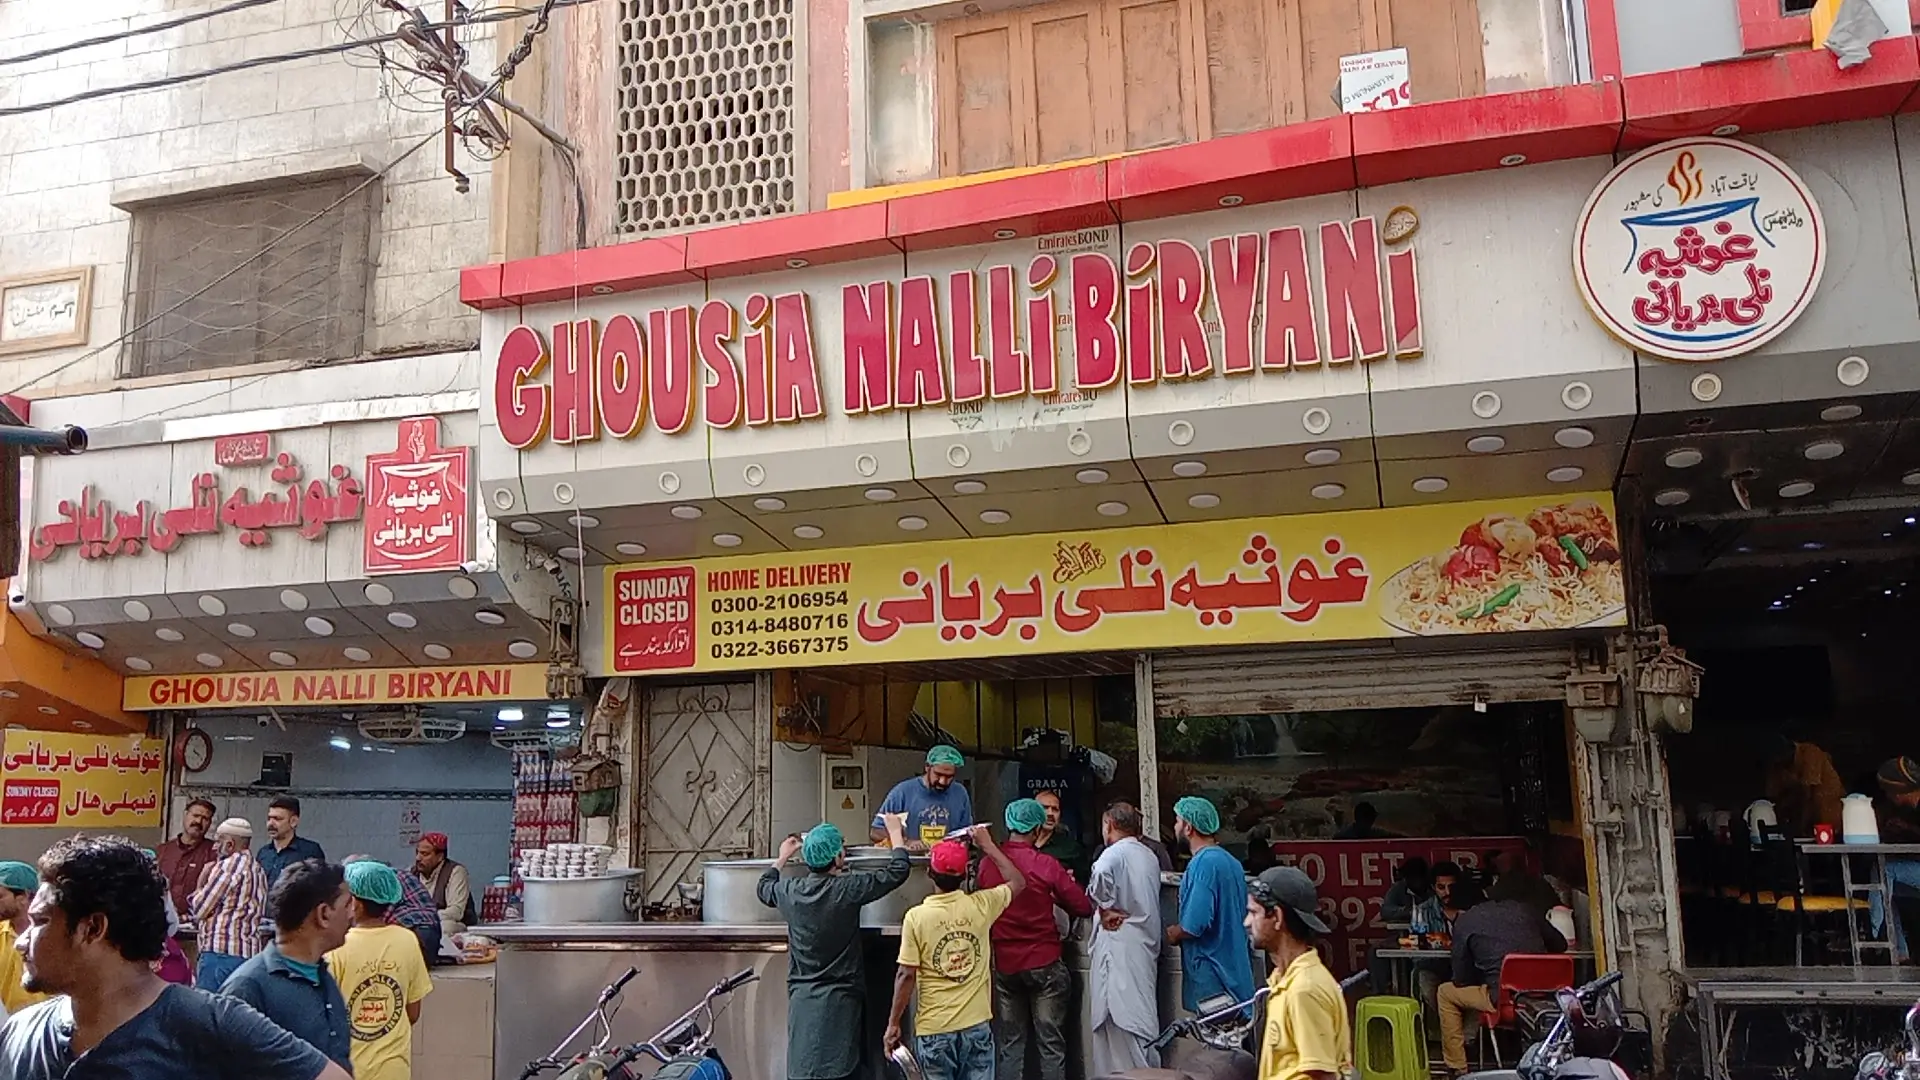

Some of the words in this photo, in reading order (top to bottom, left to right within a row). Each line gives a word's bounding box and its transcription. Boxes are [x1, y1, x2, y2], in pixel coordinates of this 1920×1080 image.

[619, 575, 690, 602] SUNDAY
[707, 568, 760, 593] HOME
[765, 562, 852, 588] DELIVERY
[1054, 549, 1165, 633] نلی
[1171, 535, 1369, 622] غوثیہ
[619, 601, 689, 627] CLOSED
[711, 590, 849, 614] 0300-2106954
[857, 561, 1043, 642] بریانی
[711, 613, 849, 637] 0314-8480716
[711, 635, 849, 659] 0322-3667375
[149, 676, 281, 704] GHOUSIA
[292, 674, 376, 701] NALLI
[386, 669, 512, 699] BIRYANI
